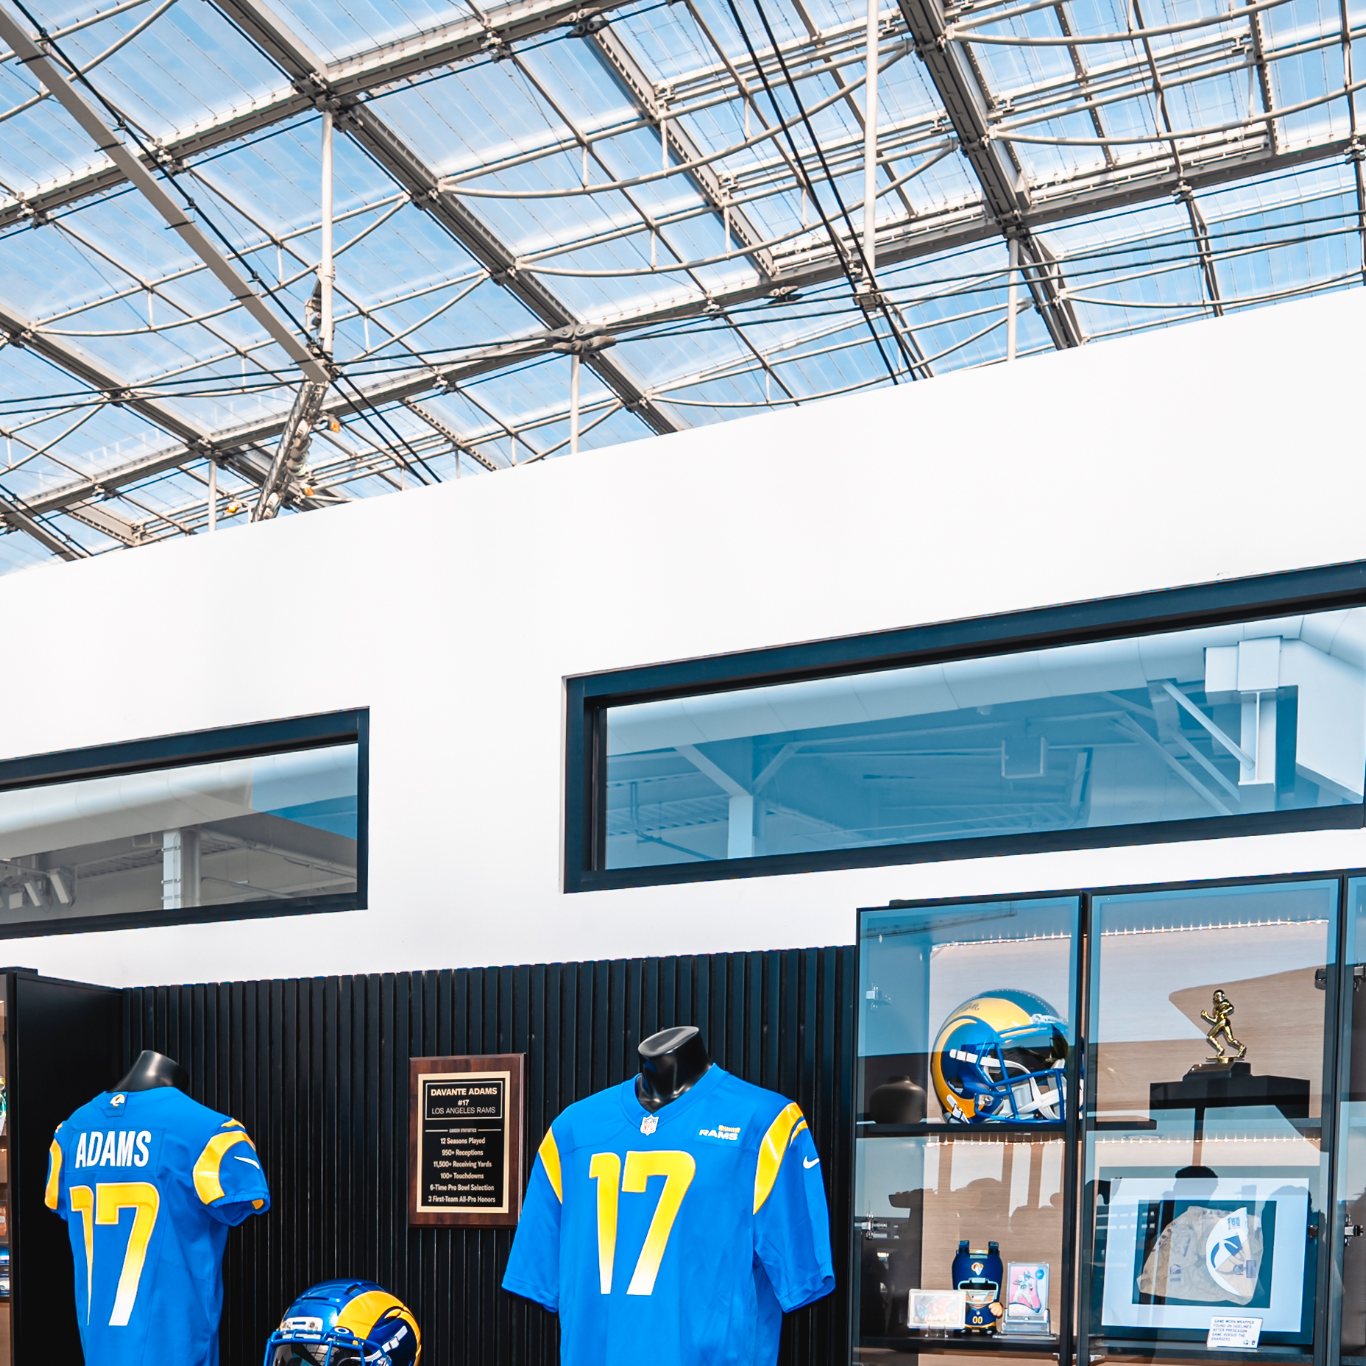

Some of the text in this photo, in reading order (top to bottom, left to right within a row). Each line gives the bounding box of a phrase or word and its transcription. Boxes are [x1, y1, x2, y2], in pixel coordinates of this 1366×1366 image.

[431, 1087, 497, 1096] DAVANTE ADAMS
[699, 1129, 738, 1141] RAMS
[469, 1137, 485, 1145] Played
[75, 1130, 152, 1168] ADAMS
[456, 1149, 484, 1157] Receptions
[453, 1161, 477, 1169] Receiving
[589, 1150, 696, 1296] 17
[69, 1182, 160, 1326] 17
[972, 1316, 983, 1324] 00
